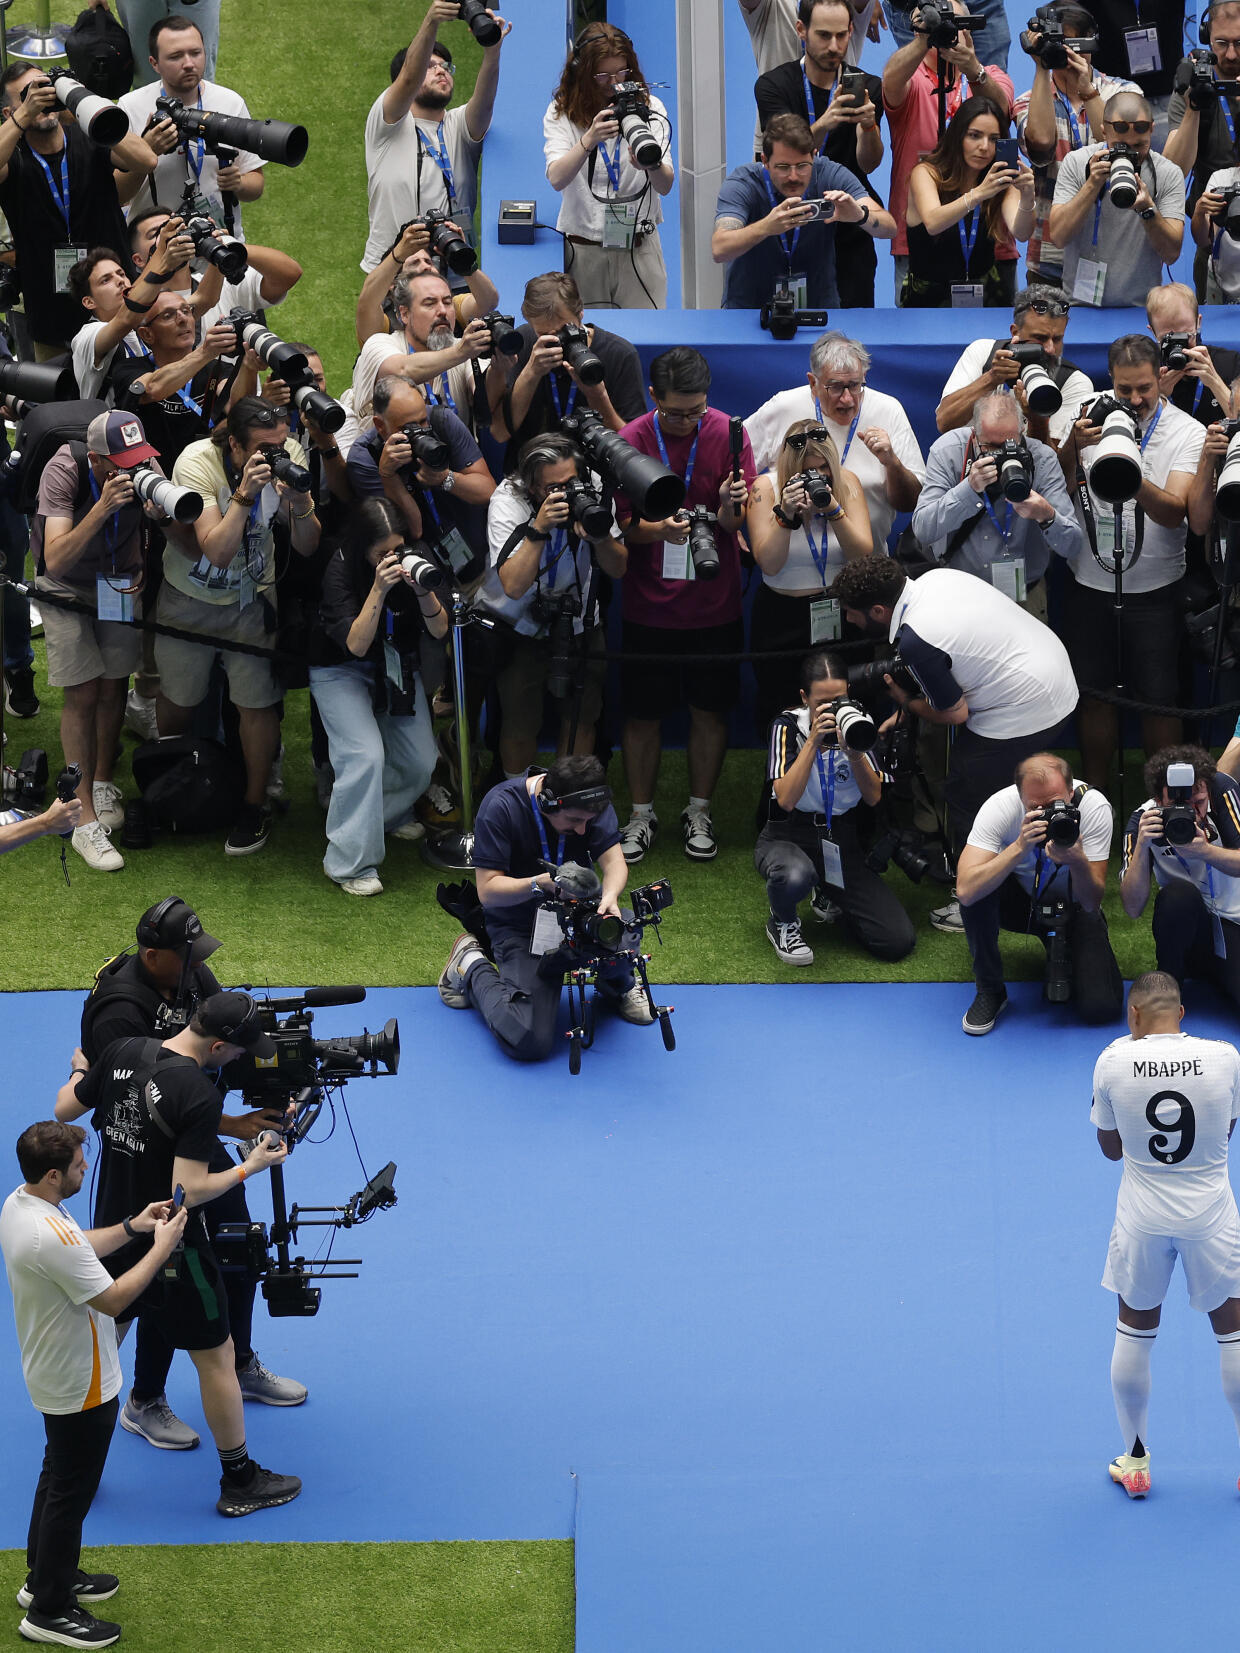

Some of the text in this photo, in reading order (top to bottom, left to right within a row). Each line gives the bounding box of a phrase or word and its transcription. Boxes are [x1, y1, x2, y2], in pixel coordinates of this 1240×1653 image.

[1080, 486, 1091, 511] SONY
[1133, 1056, 1203, 1077] MBAPPÉ
[1145, 1090, 1196, 1165] 9
